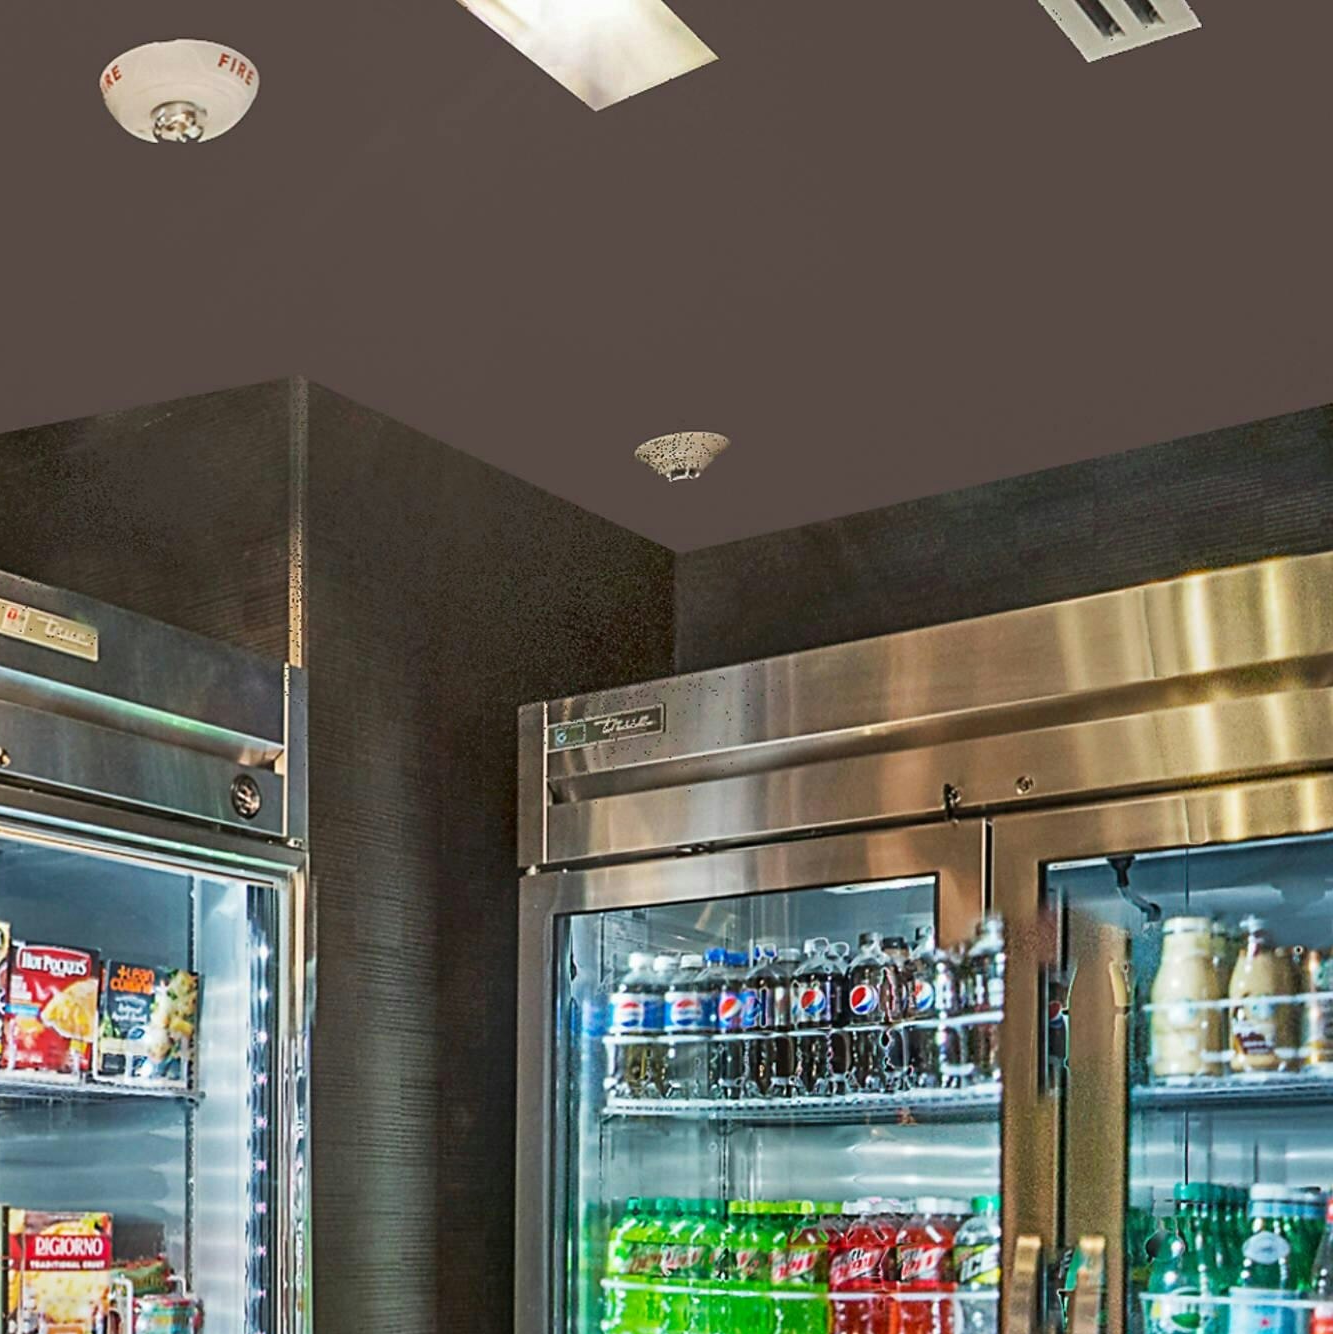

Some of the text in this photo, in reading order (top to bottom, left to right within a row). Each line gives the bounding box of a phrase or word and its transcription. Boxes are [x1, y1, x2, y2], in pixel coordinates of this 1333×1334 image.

[217, 53, 255, 86] FIRE
[34, 1236, 104, 1257] DIGIORNO
[960, 1244, 1000, 1282] ICE
